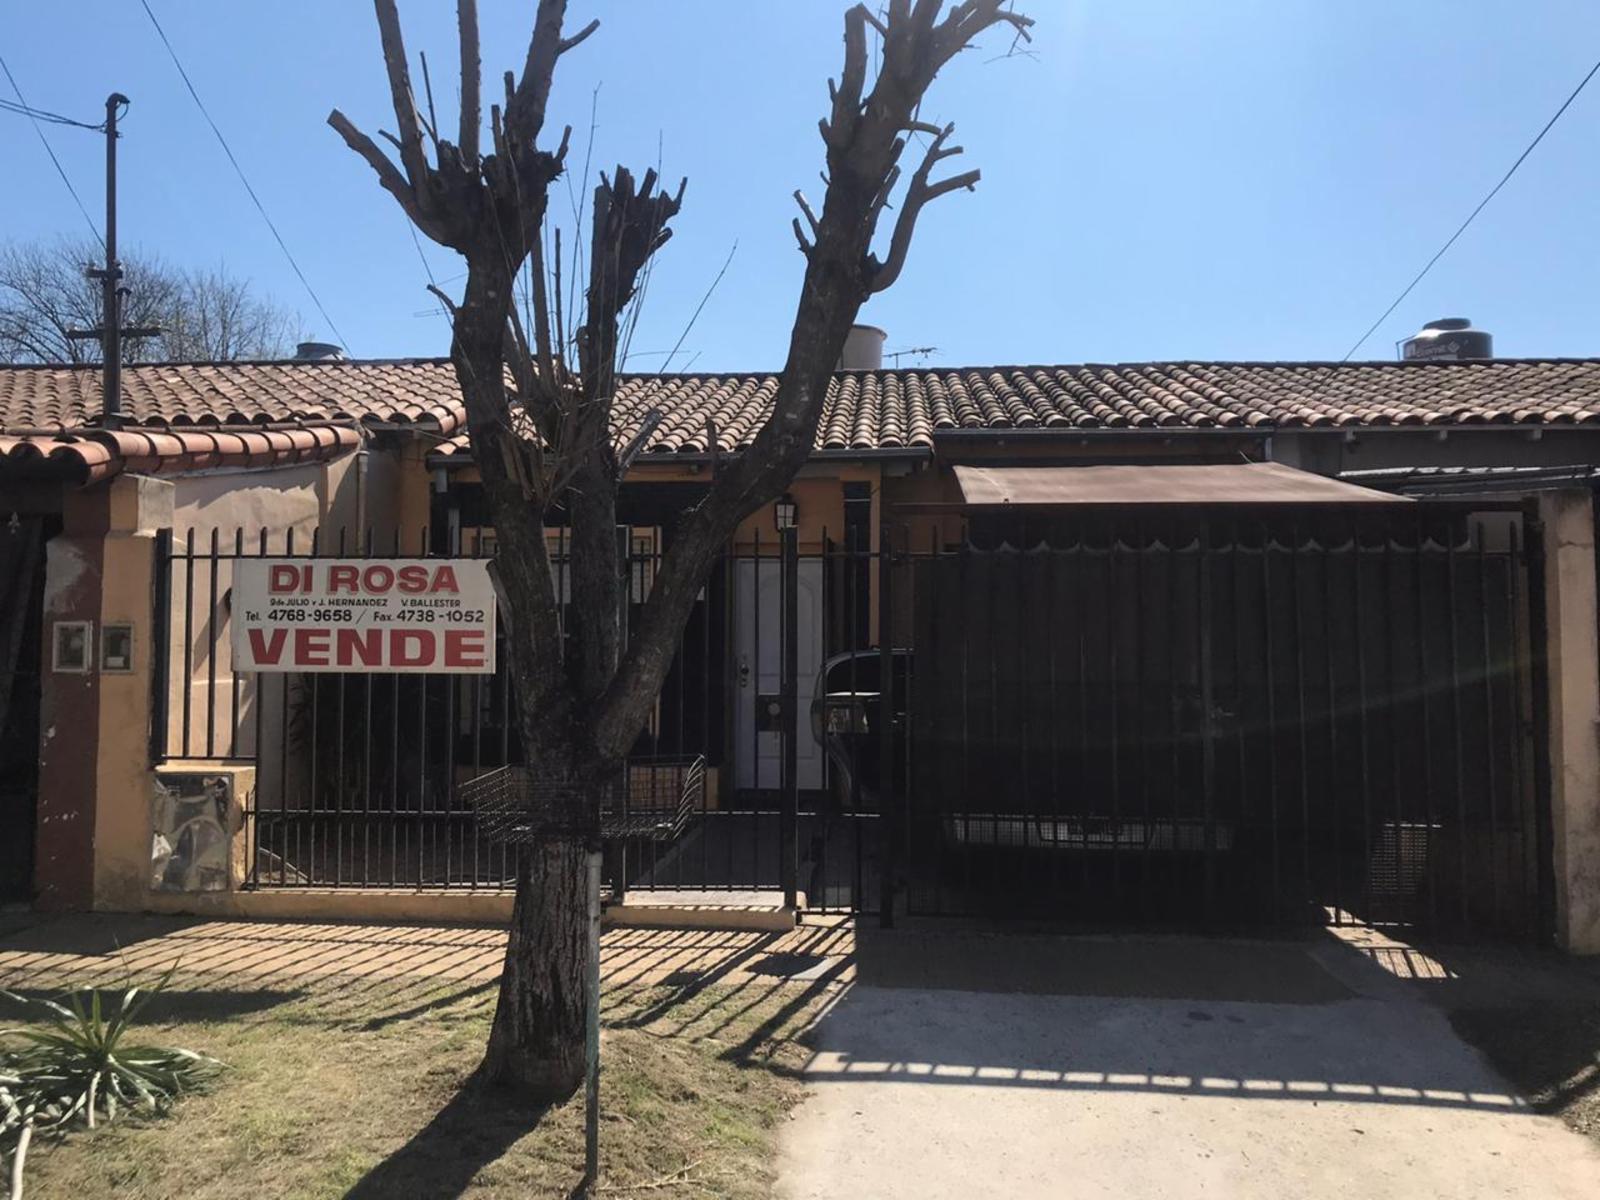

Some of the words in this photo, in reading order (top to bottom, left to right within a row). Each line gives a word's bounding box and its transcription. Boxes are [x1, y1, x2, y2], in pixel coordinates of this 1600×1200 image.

[269, 564, 313, 595] DI
[326, 564, 460, 596] ROSA
[286, 598, 310, 606] JULIO
[328, 598, 388, 607] HERNANDEZ
[268, 609, 352, 622] 4768-9658
[248, 628, 485, 667] VENDE
